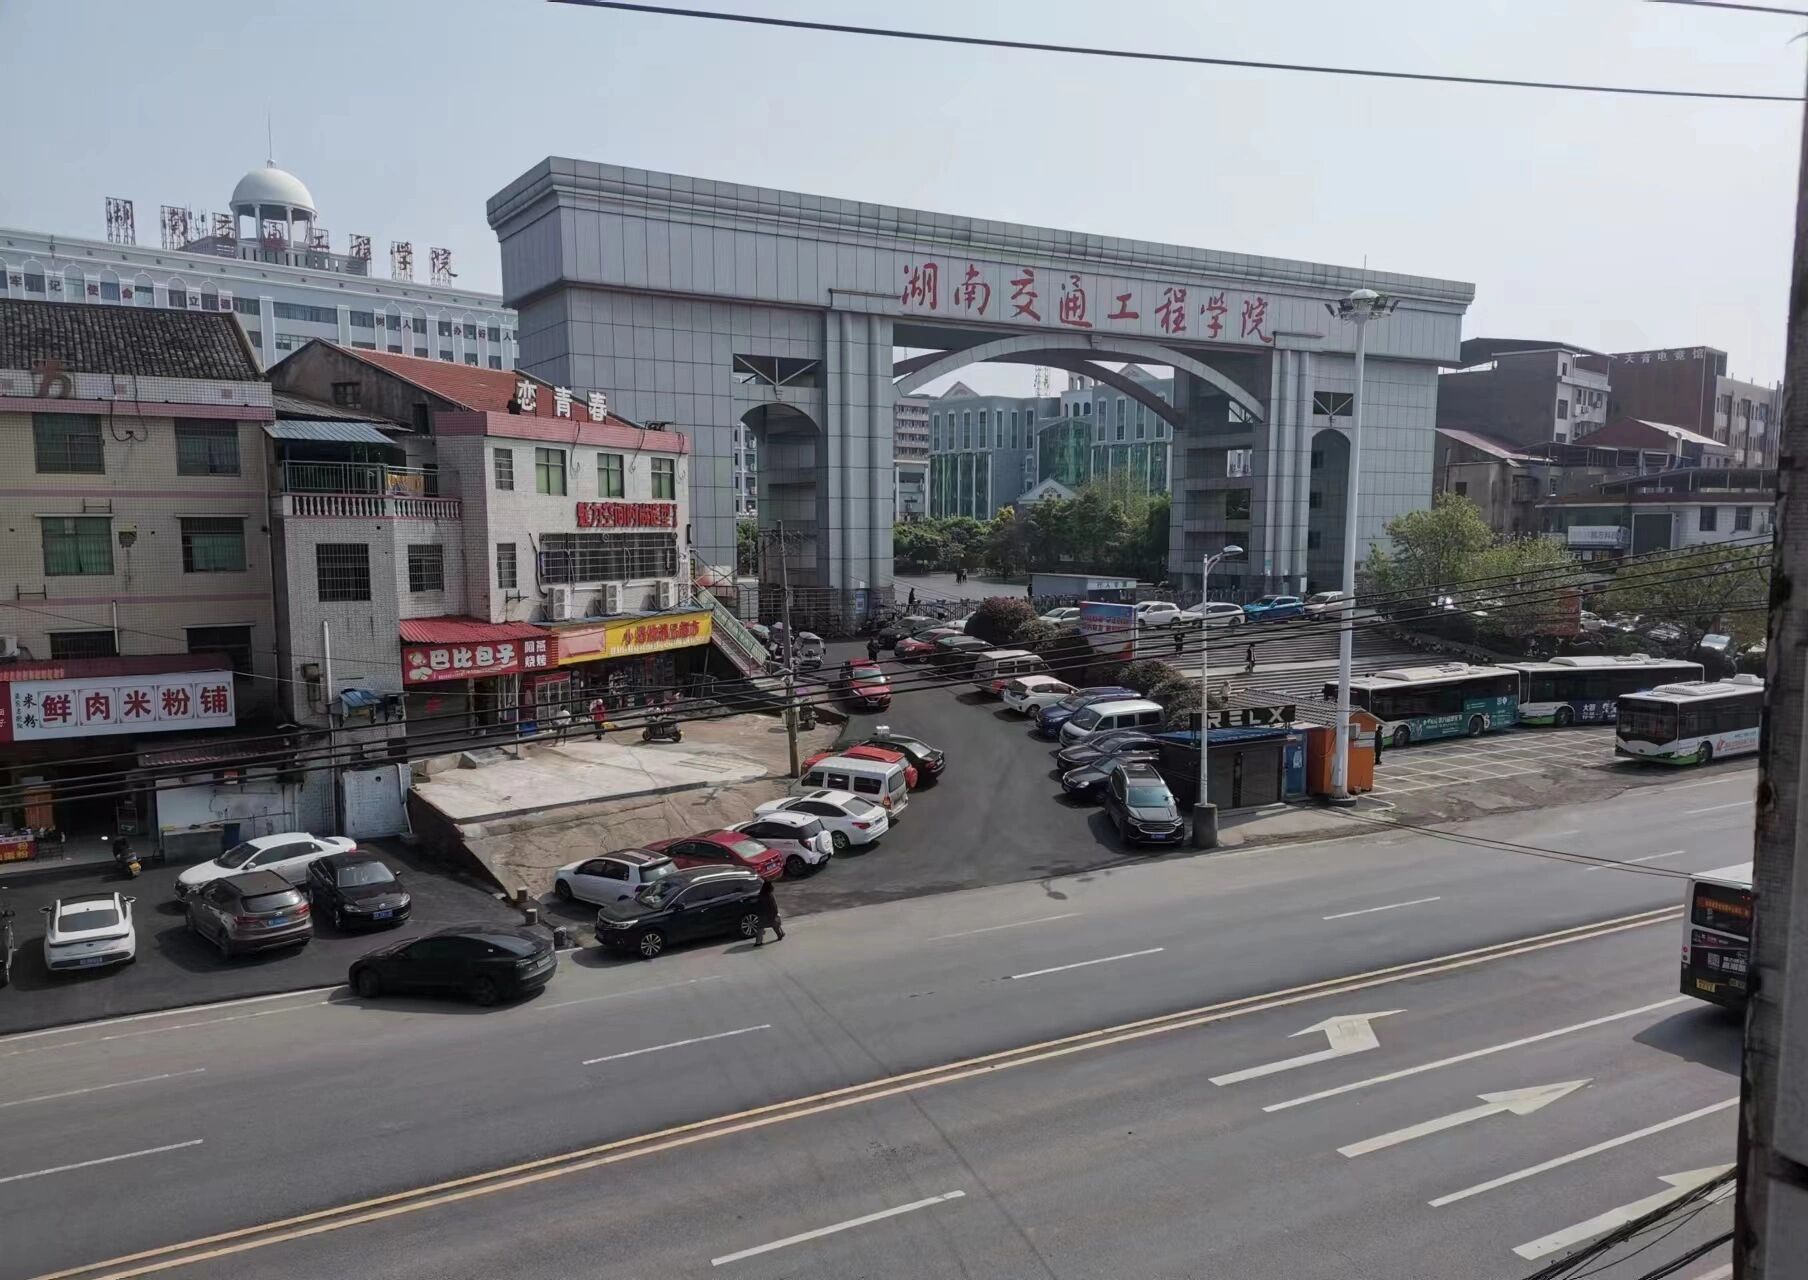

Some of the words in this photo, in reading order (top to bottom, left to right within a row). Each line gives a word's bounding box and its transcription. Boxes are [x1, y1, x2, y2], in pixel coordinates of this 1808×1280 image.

[901, 262, 1273, 344] 湖南交通工程学院
[517, 379, 607, 422] 恋青春
[429, 643, 515, 671] 巴比包子
[524, 654, 547, 667] 烧烤
[22, 692, 39, 729] 米粉
[41, 685, 229, 724] 鲜肉米粉铺
[1206, 706, 1286, 729] RELX
